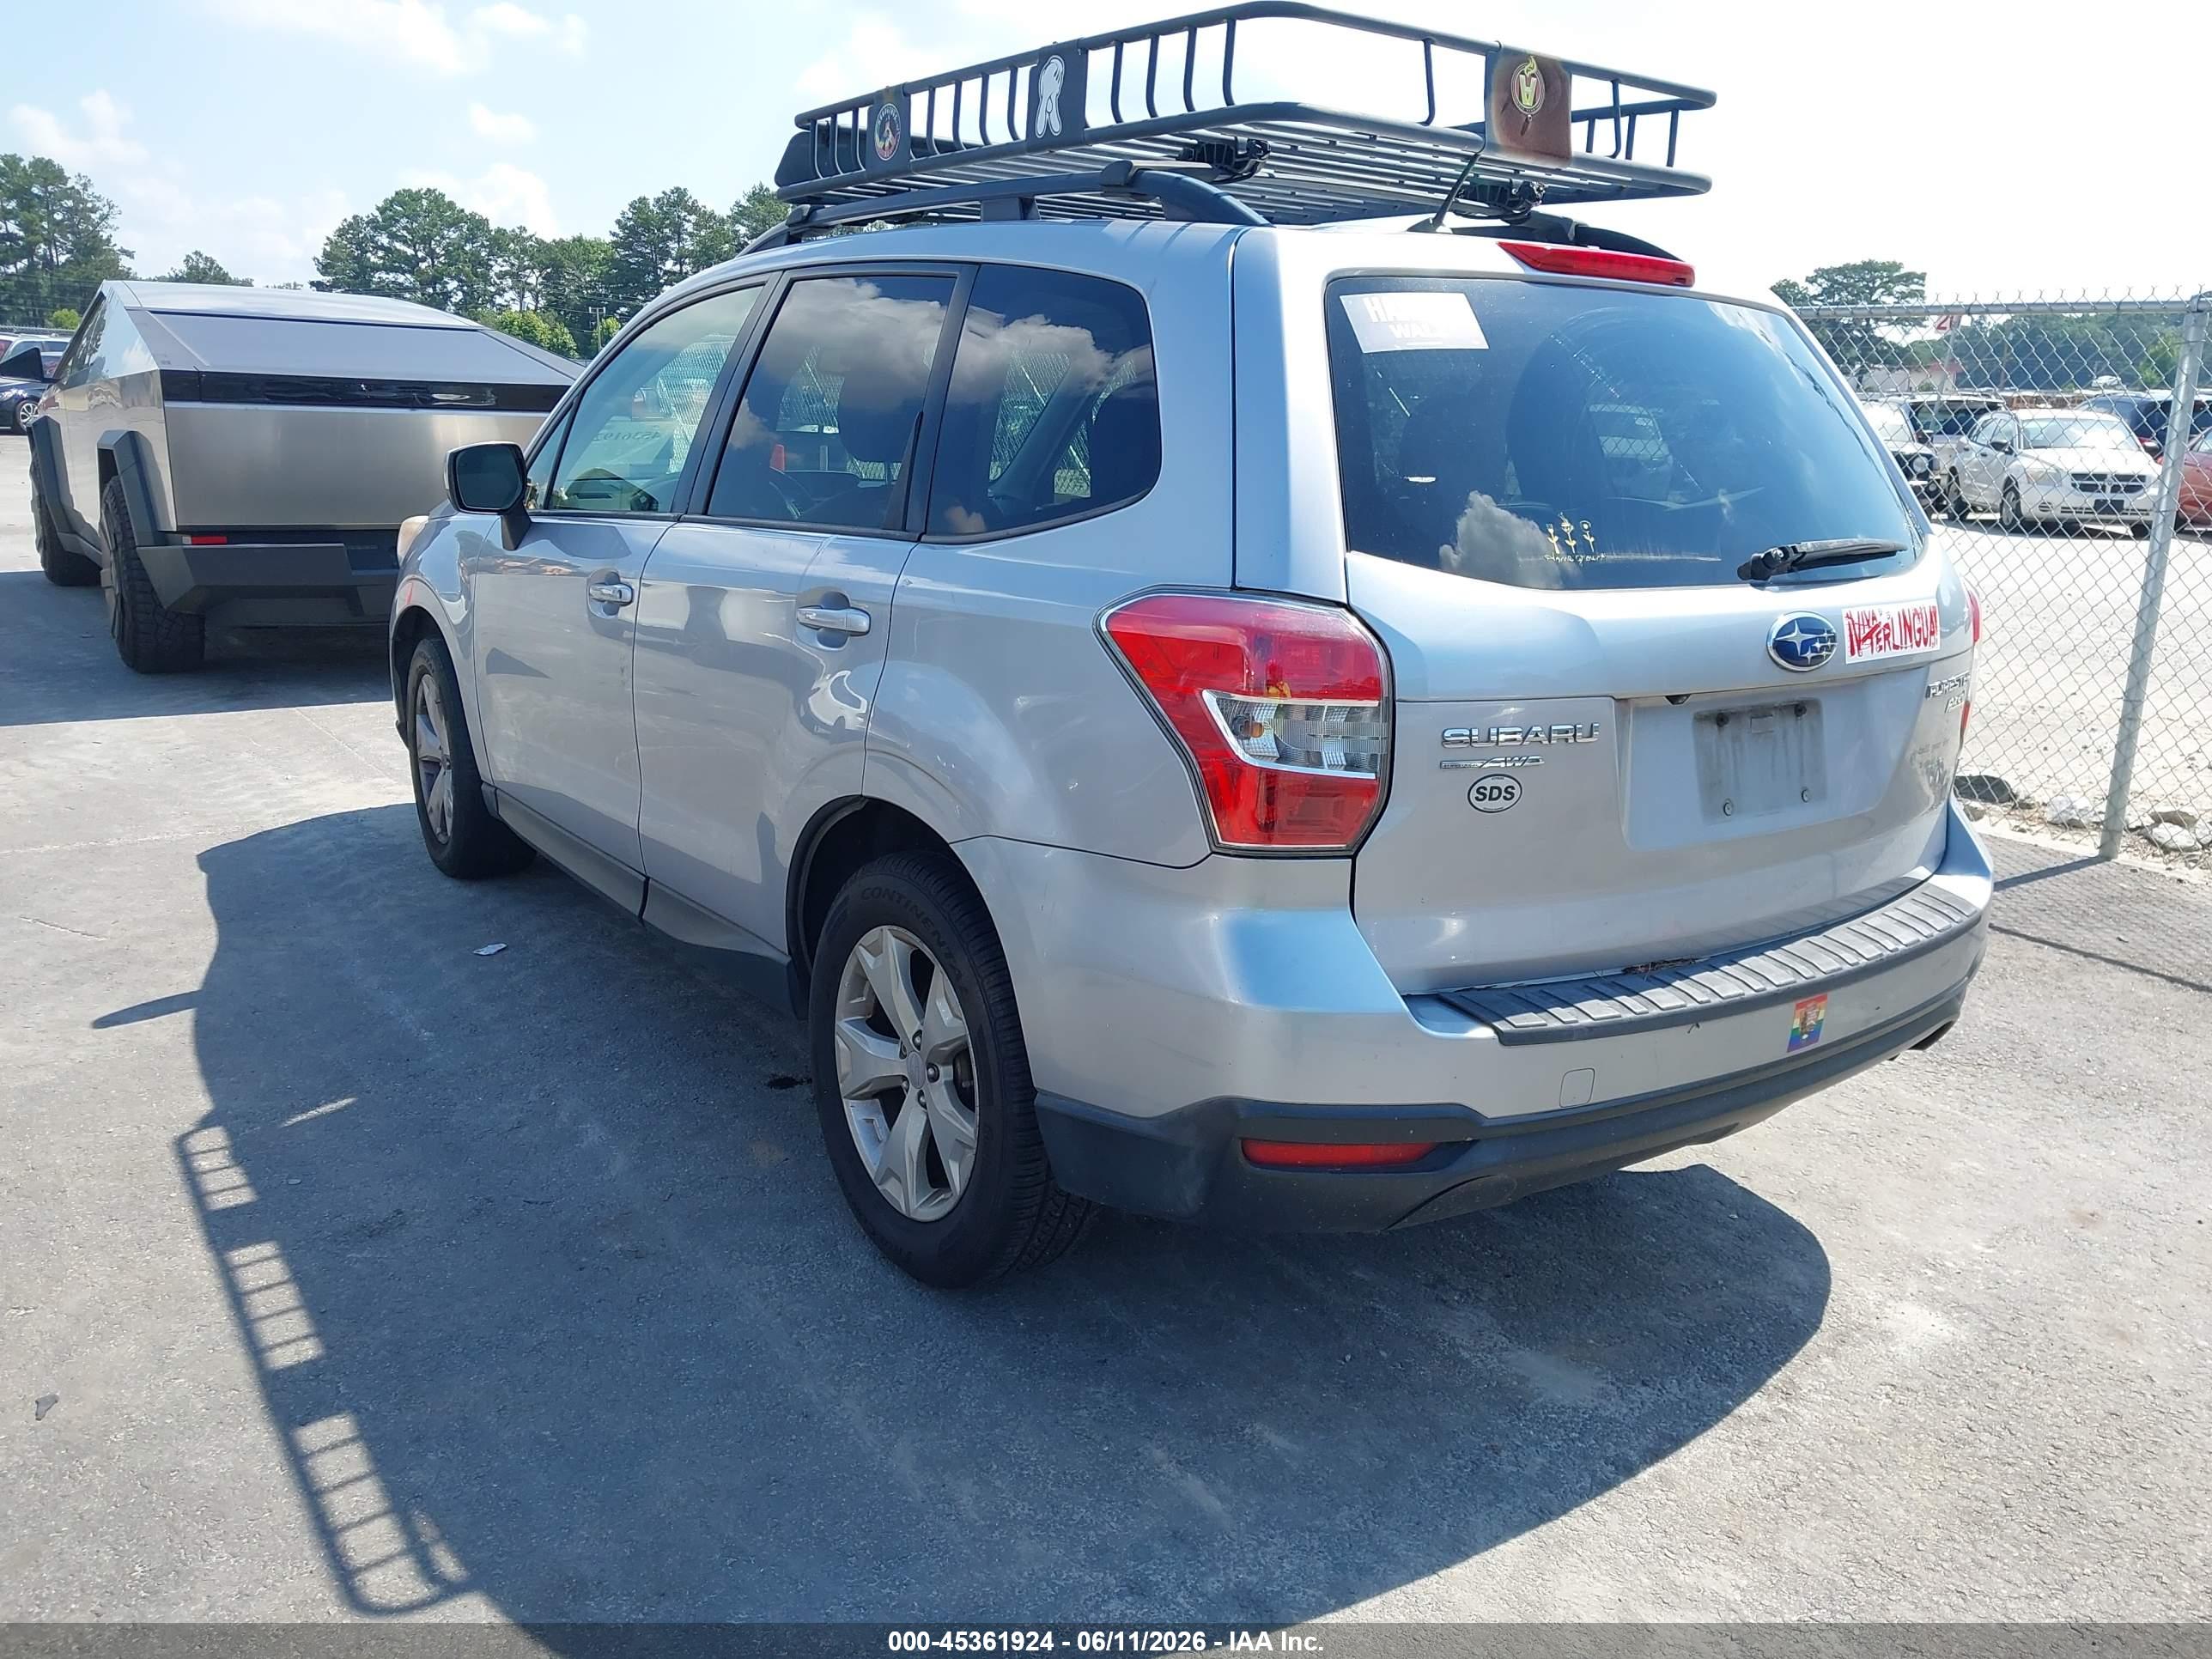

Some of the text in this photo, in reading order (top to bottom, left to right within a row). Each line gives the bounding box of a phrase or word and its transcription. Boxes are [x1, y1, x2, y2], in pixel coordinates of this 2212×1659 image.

[1441, 722, 1601, 749] SUBARU
[1480, 756, 1545, 769] AWD
[1474, 785, 1516, 802] SDS
